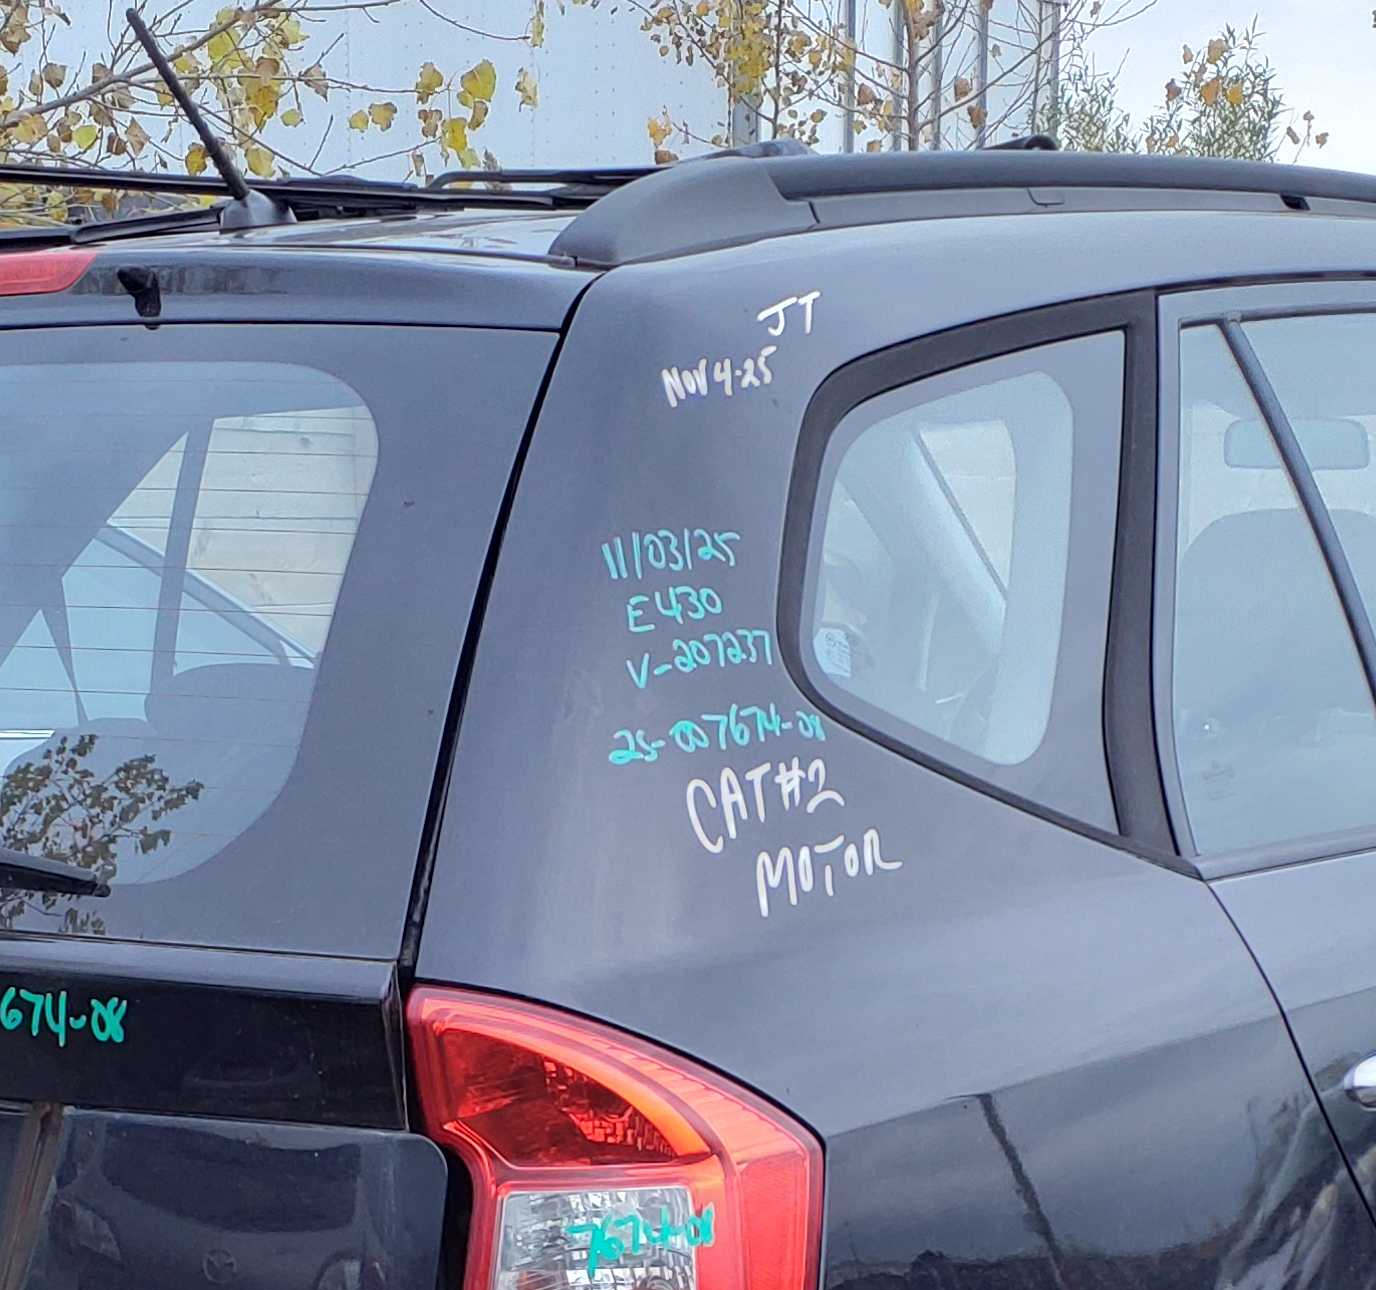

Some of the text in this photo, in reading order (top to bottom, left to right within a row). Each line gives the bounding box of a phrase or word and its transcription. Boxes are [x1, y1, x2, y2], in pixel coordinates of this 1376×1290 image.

[756, 290, 821, 336] JT
[601, 528, 741, 580] 11/03/25
[756, 828, 904, 918] MOTOR
